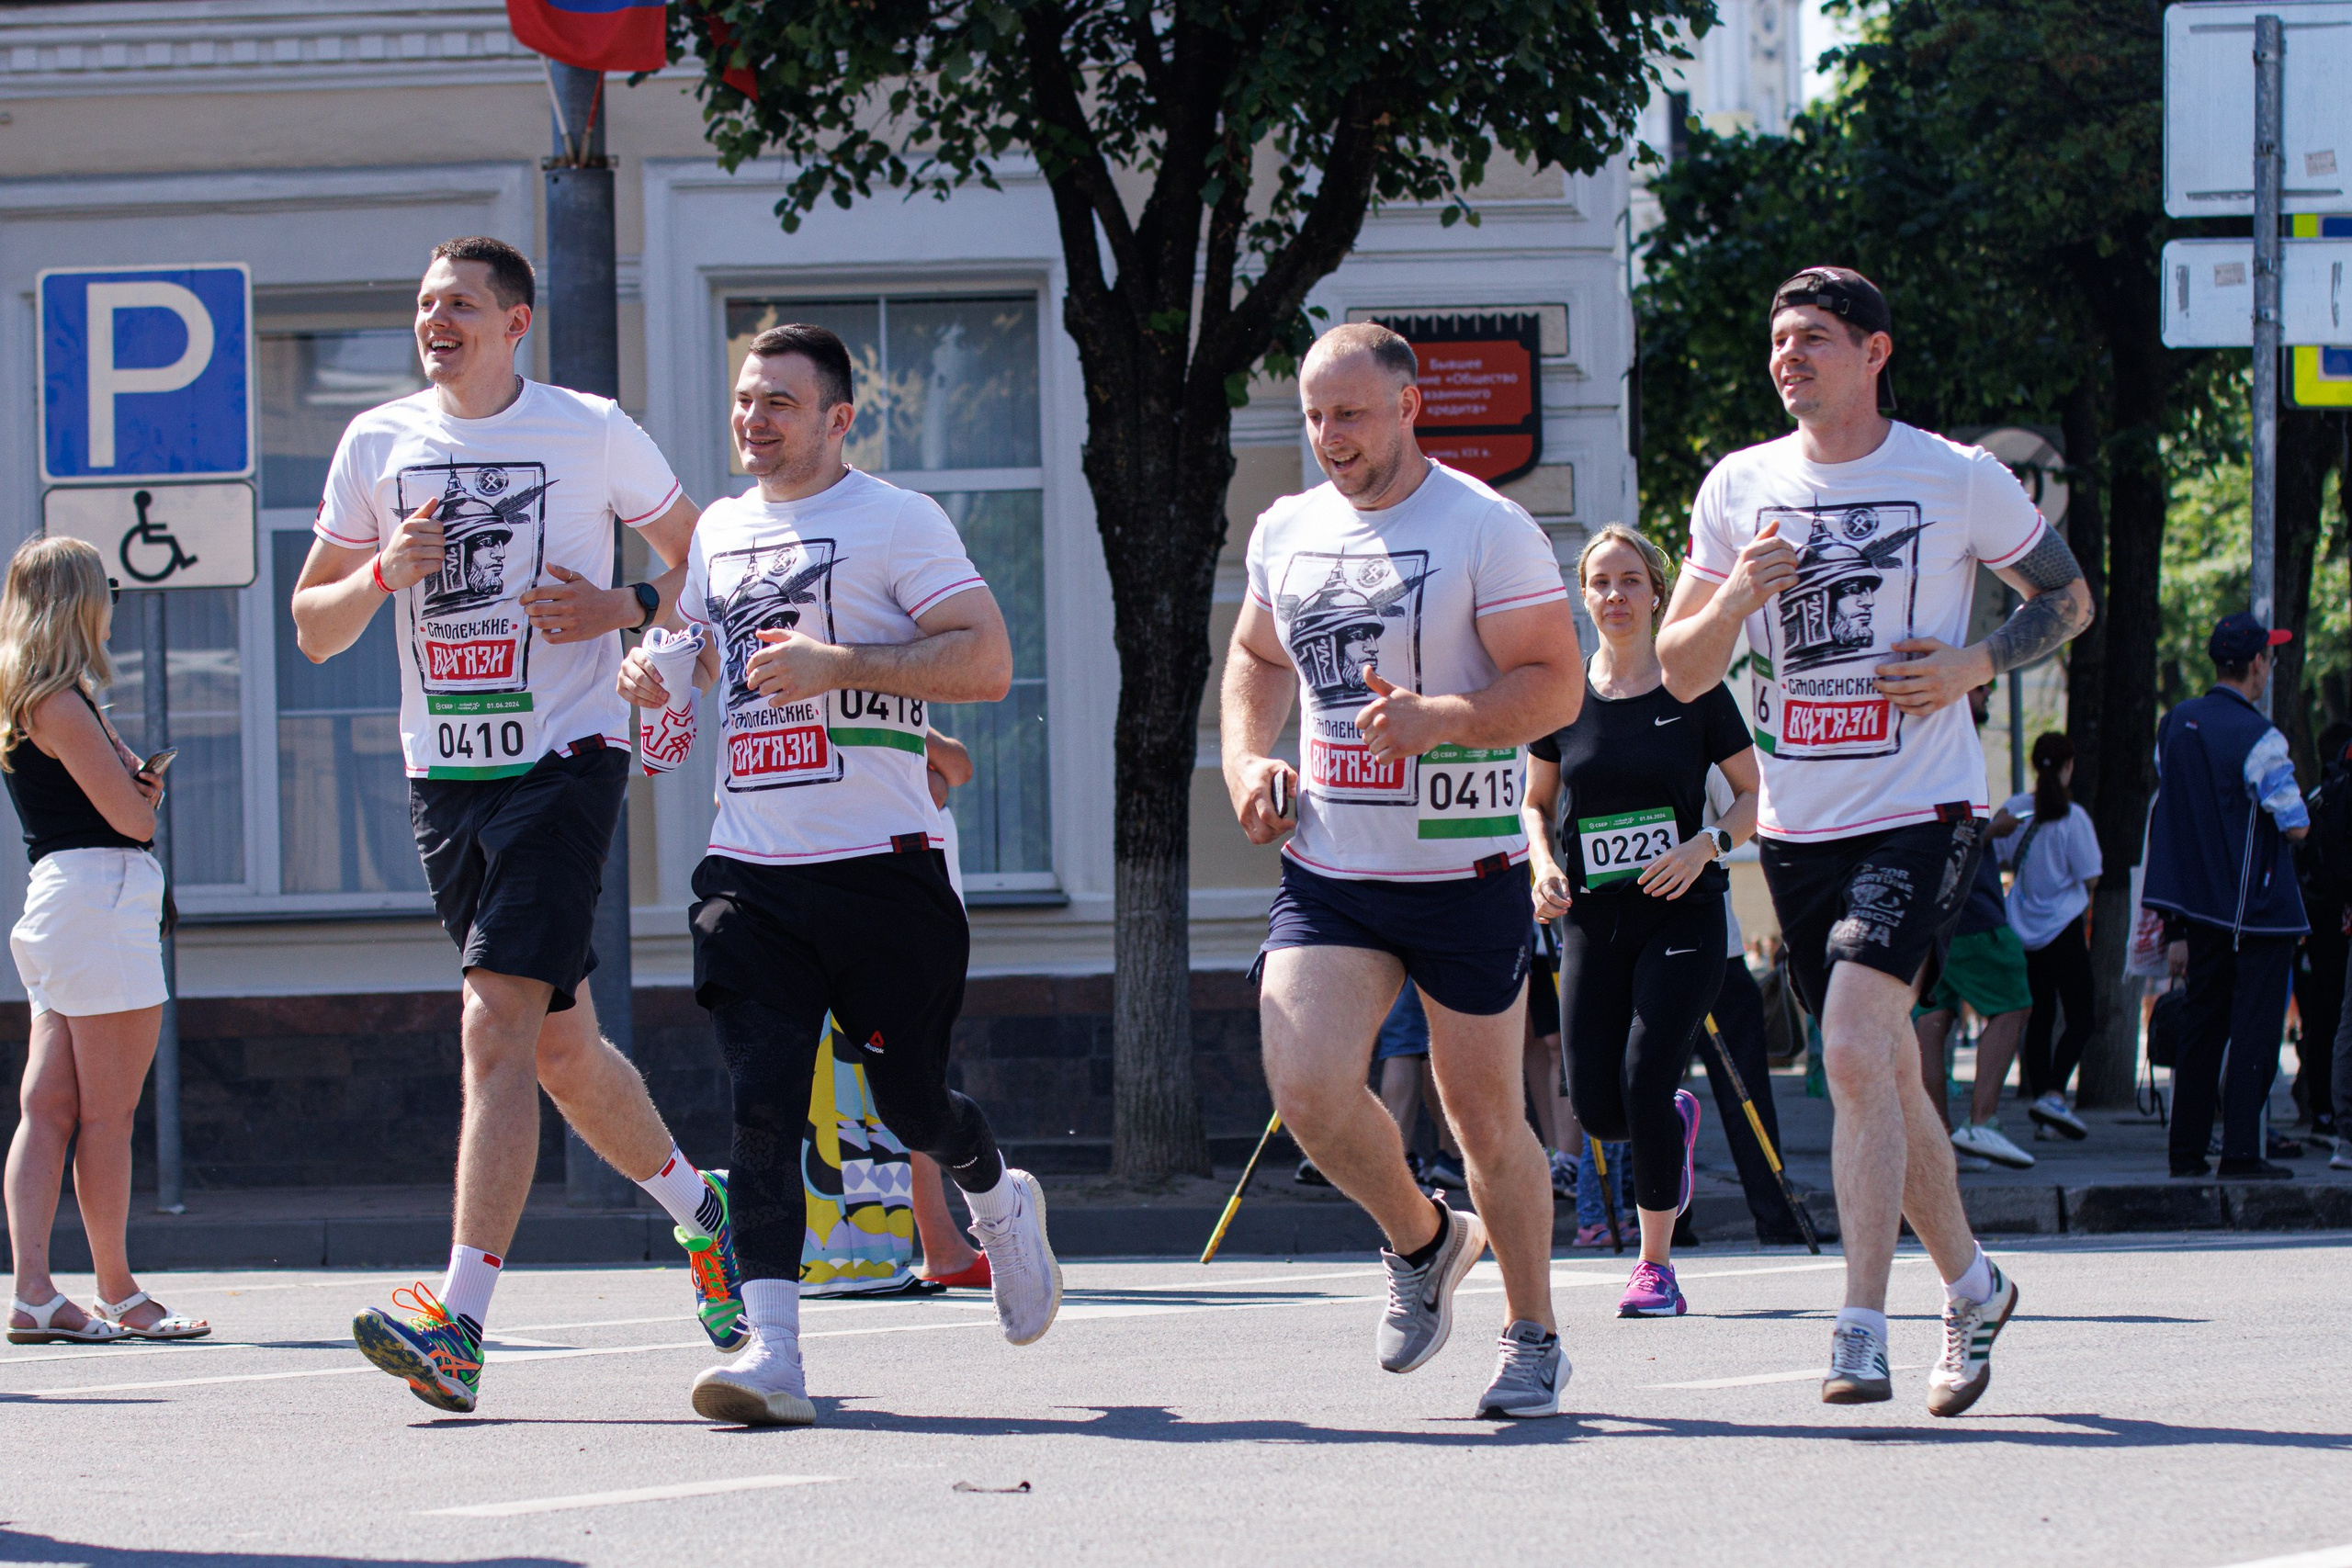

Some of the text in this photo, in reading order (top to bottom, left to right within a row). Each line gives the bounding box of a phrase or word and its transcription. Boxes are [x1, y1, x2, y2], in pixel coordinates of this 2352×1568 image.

[86, 281, 214, 468] P
[486, 701, 520, 709] 01.06.2024
[1751, 679, 1770, 723] 16
[1788, 678, 1883, 696] СМОЛЕНСКИ
[841, 689, 923, 728] 0418
[1788, 705, 1882, 740] ВИТЯЗИ
[438, 720, 524, 759] 0410
[733, 731, 817, 771] ВИТЯЗИ
[1430, 769, 1514, 810] 0415
[1591, 829, 1672, 866] 0223
